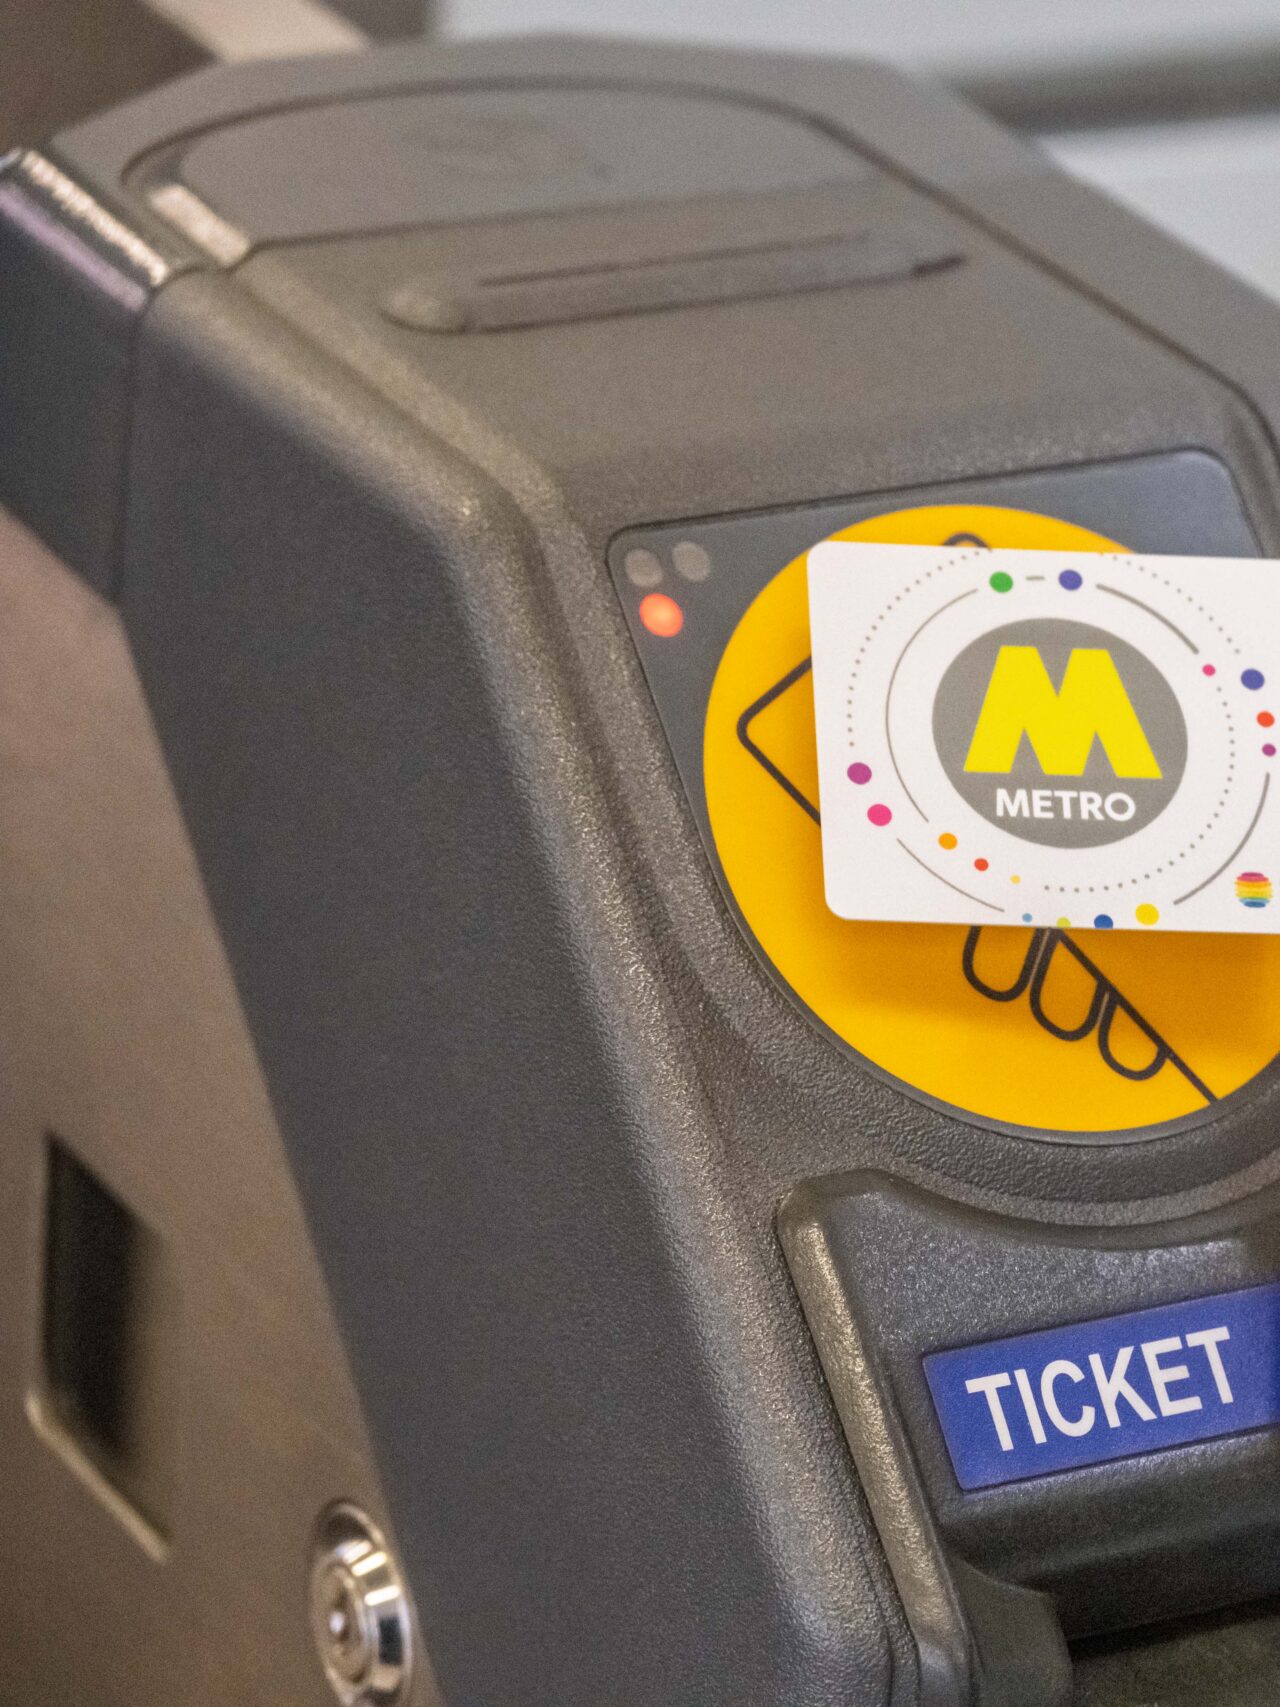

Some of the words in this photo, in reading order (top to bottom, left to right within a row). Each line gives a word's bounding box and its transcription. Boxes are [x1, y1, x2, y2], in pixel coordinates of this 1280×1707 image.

[963, 645, 1163, 779] M
[996, 788, 1136, 822] METRO
[965, 1326, 1232, 1451] TICKET
